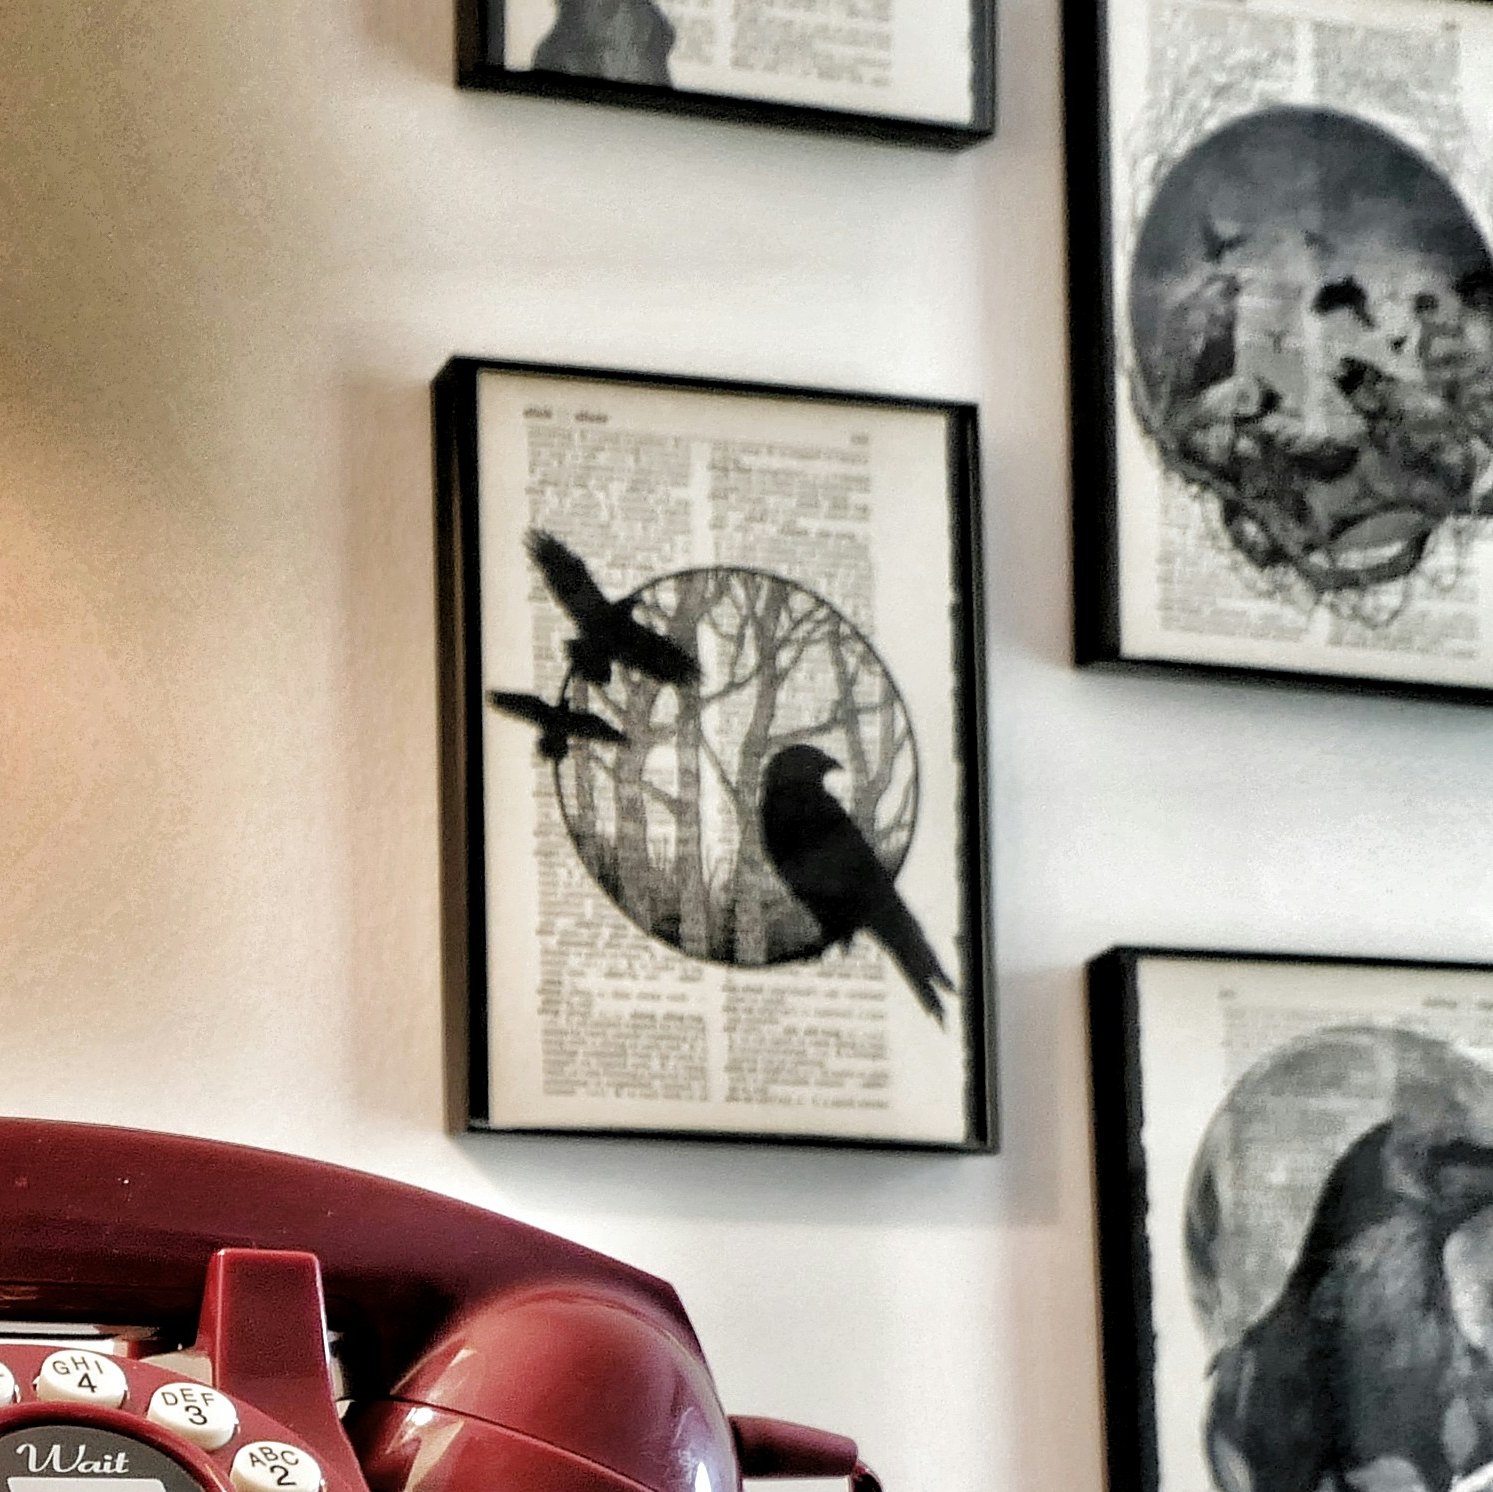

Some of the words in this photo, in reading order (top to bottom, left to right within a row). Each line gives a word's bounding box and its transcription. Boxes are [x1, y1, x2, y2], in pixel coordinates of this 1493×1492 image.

[52, 1356, 103, 1375] GHI
[76, 1373, 97, 1393] 4
[161, 1387, 215, 1407] DEF
[185, 1405, 208, 1426] 3
[16, 1443, 129, 1474] Wait
[248, 1446, 299, 1467] ABC
[269, 1465, 296, 1486] 2
